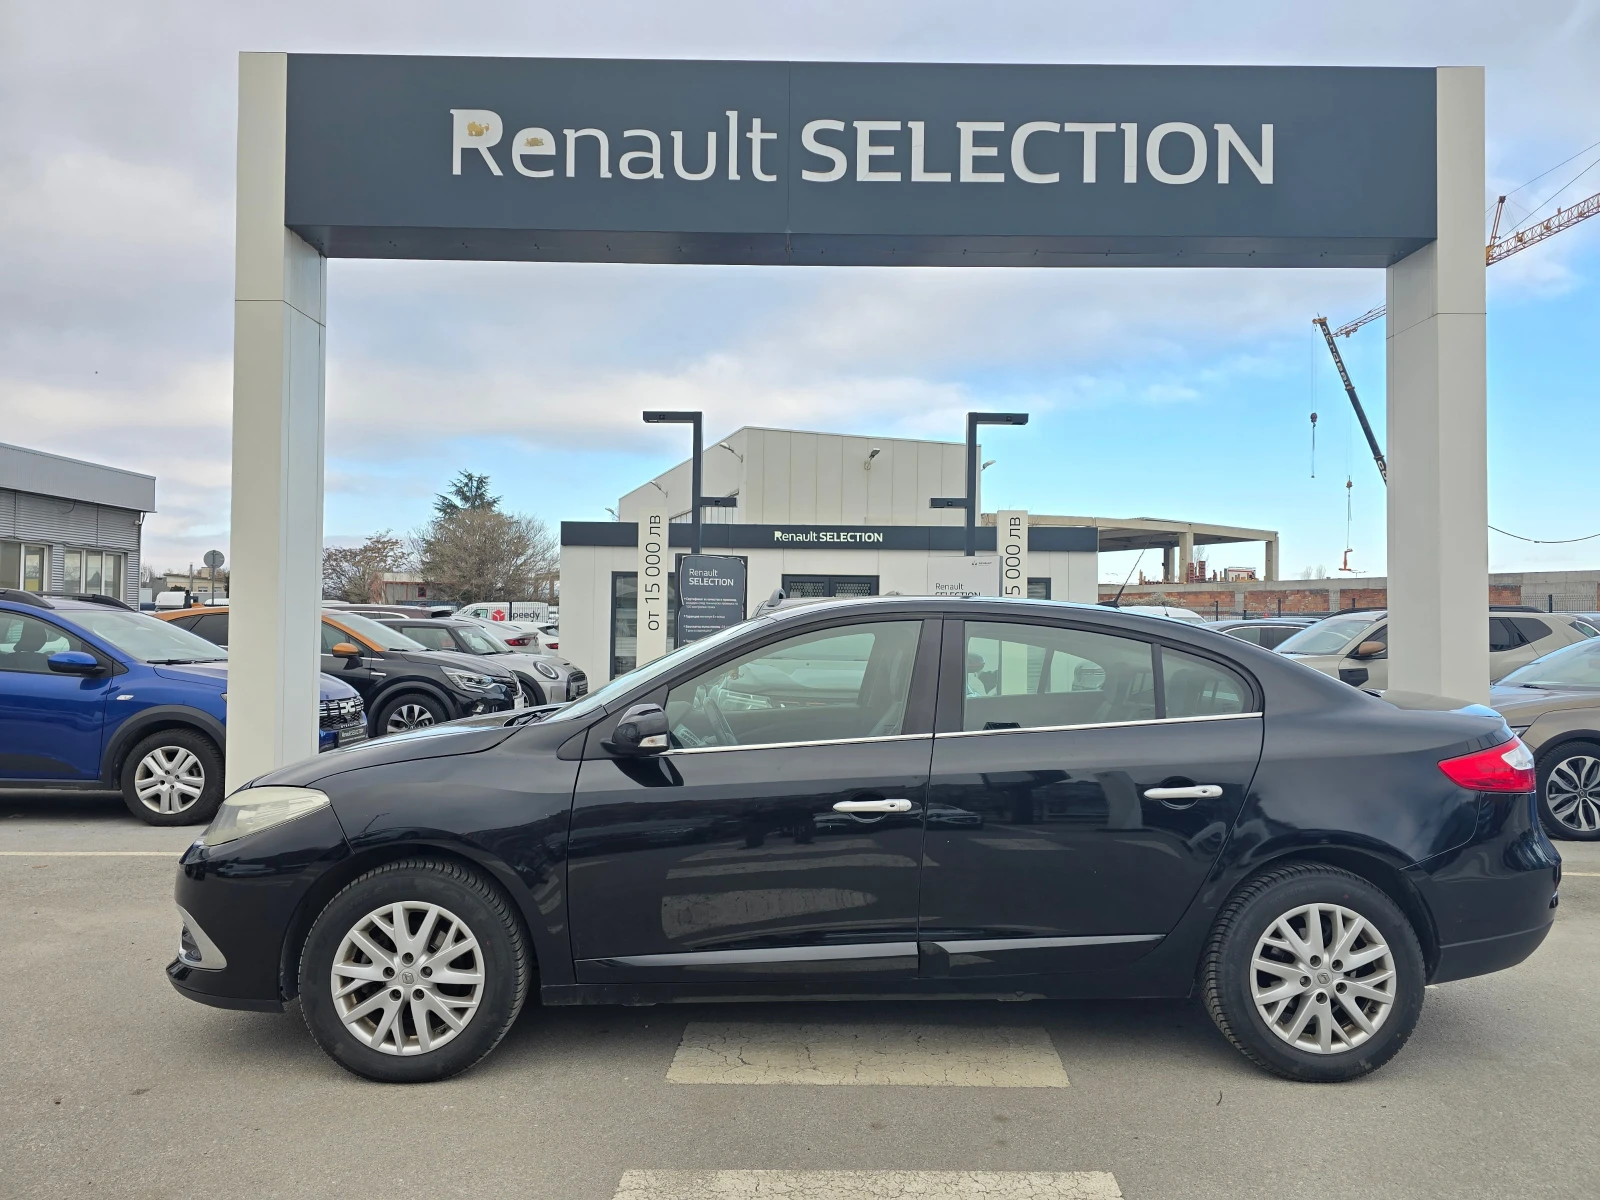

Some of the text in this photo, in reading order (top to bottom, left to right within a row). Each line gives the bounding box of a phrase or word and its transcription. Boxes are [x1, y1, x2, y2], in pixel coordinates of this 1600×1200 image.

[450, 108, 1274, 184] Renault SELECTION
[774, 531, 883, 543] Renault SELECTION
[645, 542, 660, 577] 000
[1005, 544, 1021, 579] 000
[688, 568, 718, 577] Renault
[688, 577, 734, 586] SELECTION
[935, 582, 964, 591] Renault
[645, 583, 660, 604] 15
[509, 610, 540, 620] peedy
